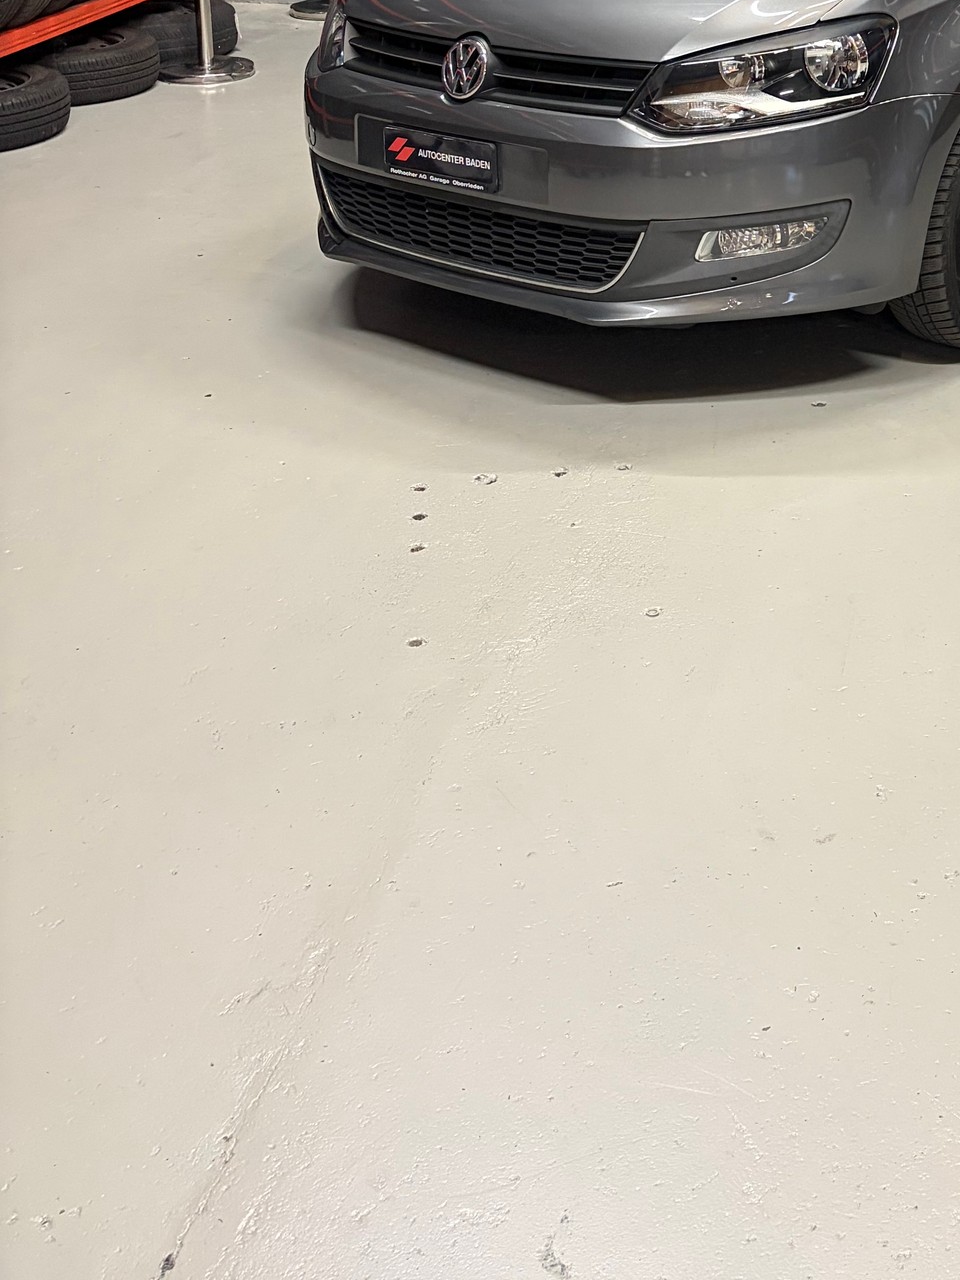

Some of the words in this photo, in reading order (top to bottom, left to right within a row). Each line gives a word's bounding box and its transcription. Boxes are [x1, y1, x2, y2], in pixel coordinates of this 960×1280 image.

[418, 149, 464, 165] AUTOCENTER
[465, 157, 491, 170] BADEN
[429, 176, 450, 185] Garage
